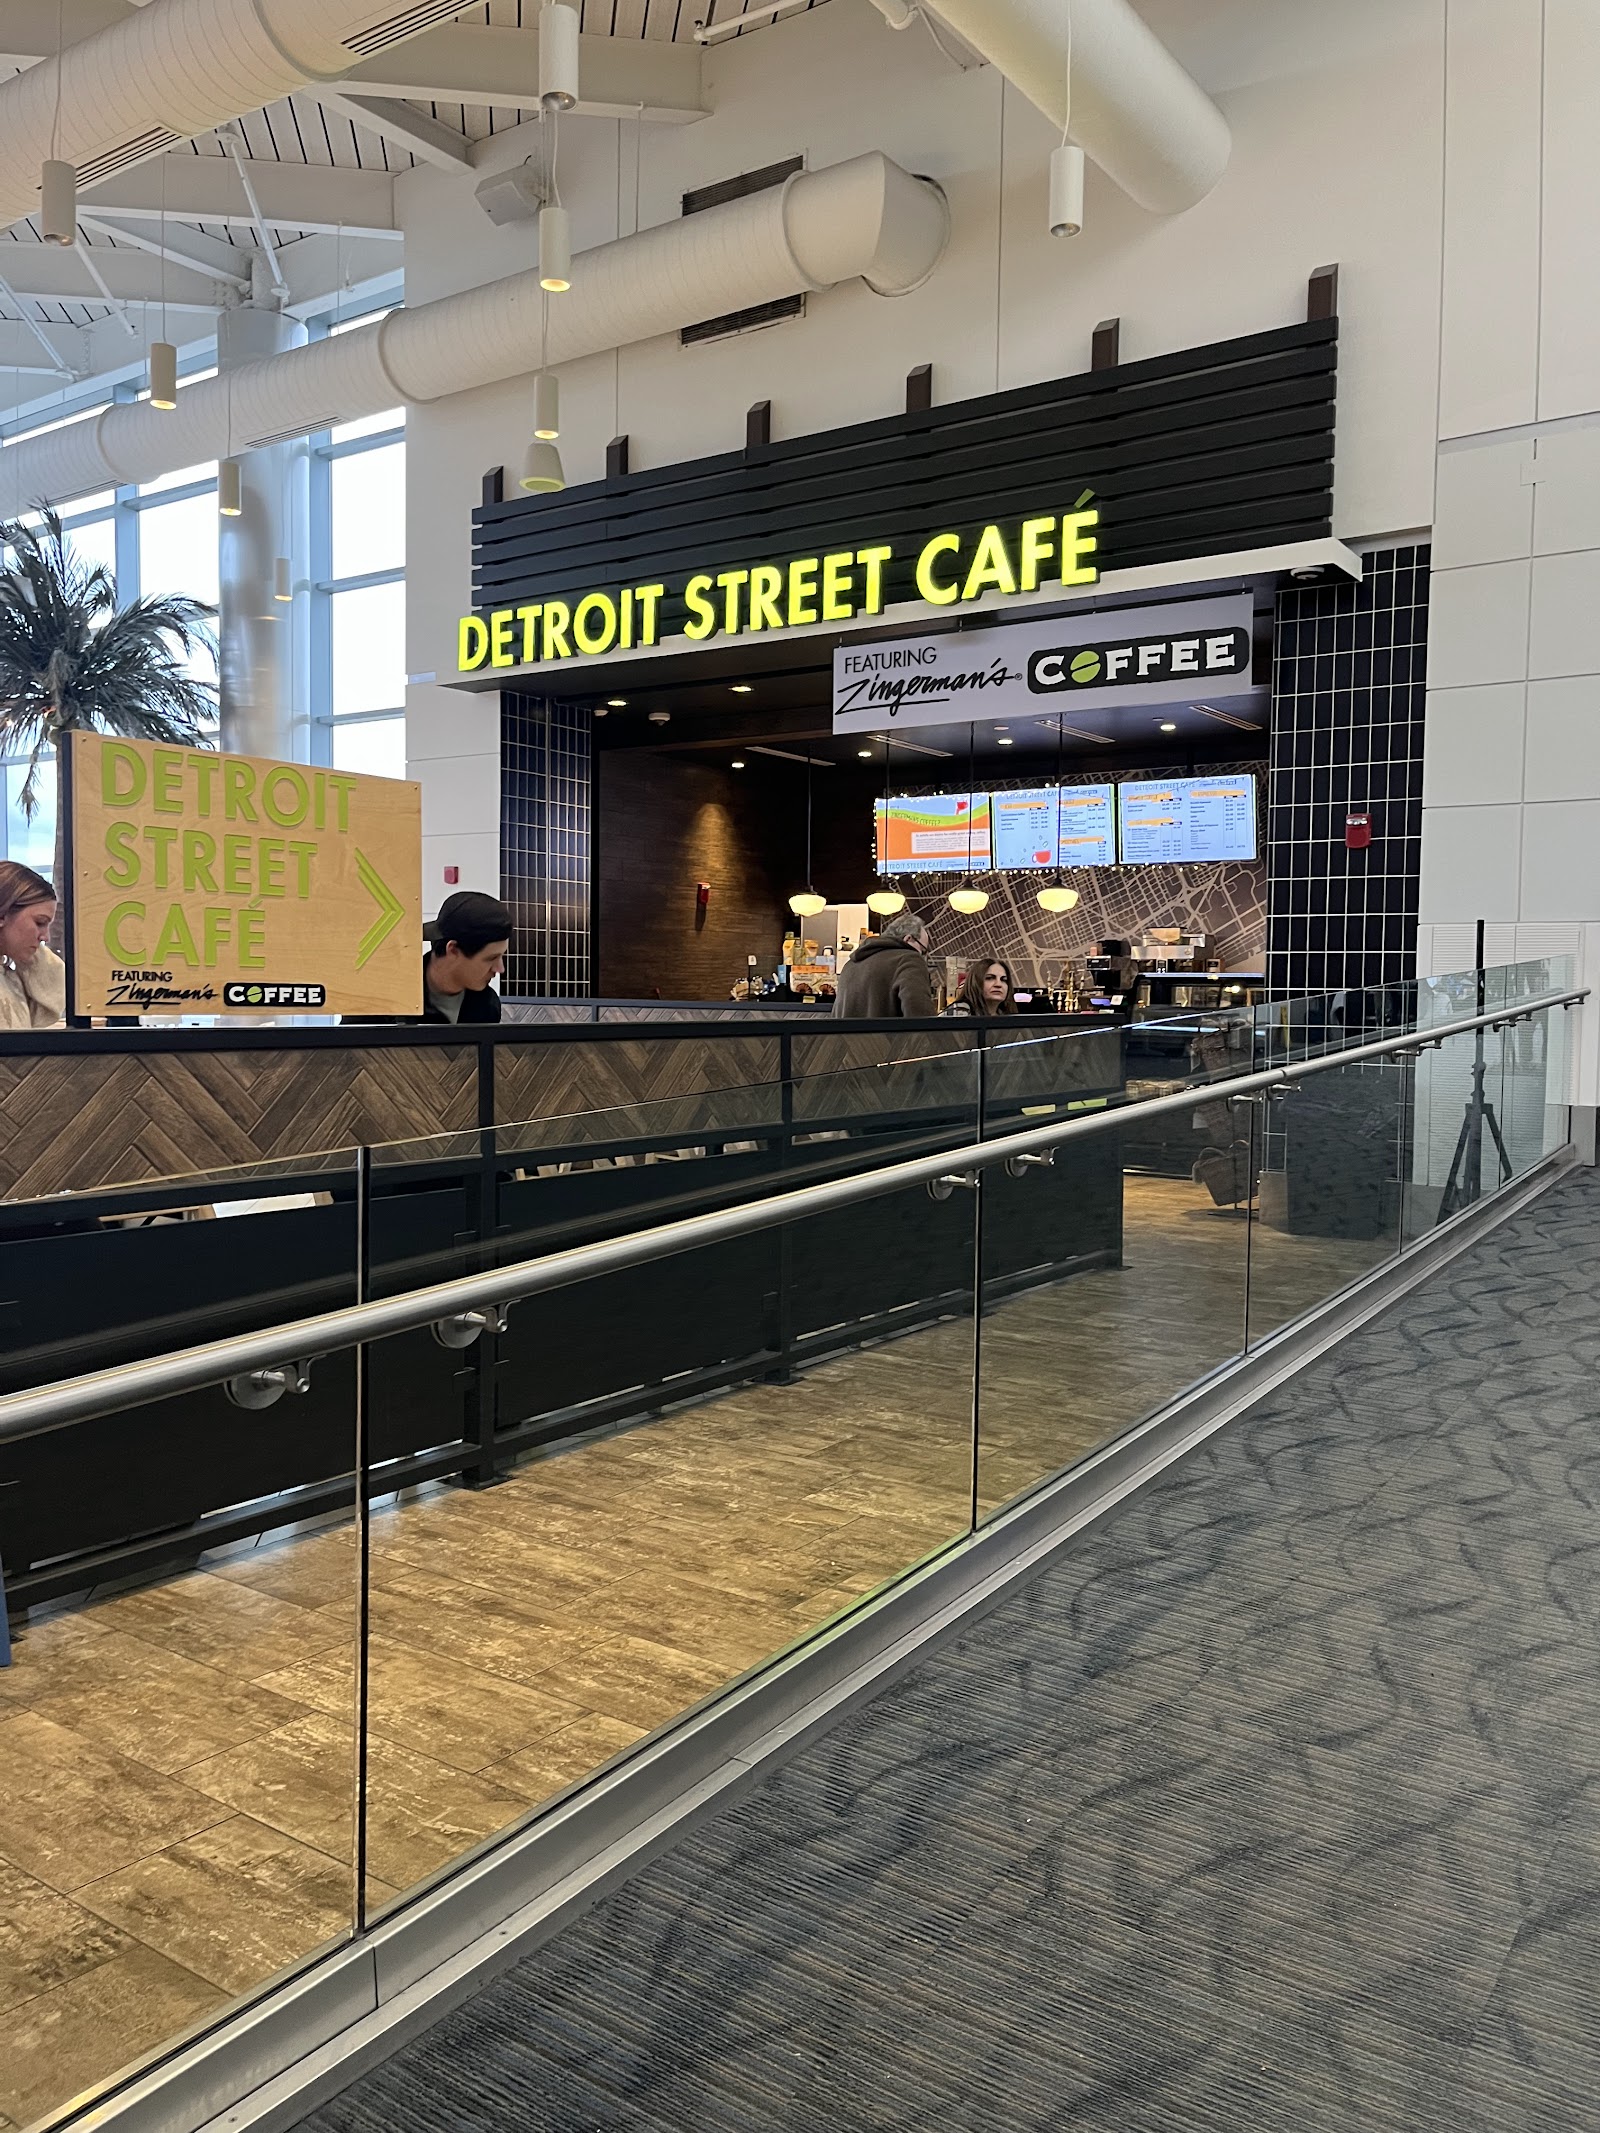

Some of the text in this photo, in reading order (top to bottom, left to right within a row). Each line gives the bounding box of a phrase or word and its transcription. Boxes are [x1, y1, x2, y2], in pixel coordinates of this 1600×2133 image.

[457, 488, 1100, 672] DETROIT STREET CAFÉ
[844, 647, 936, 674] FEATURING
[1034, 633, 1236, 686] COFFEE
[101, 741, 358, 832] DETROIT
[103, 822, 318, 899] STREET
[103, 898, 266, 968] CAFÉ
[106, 983, 321, 1010] Zingerman's COFFEE
[112, 970, 173, 982] FEATURING
